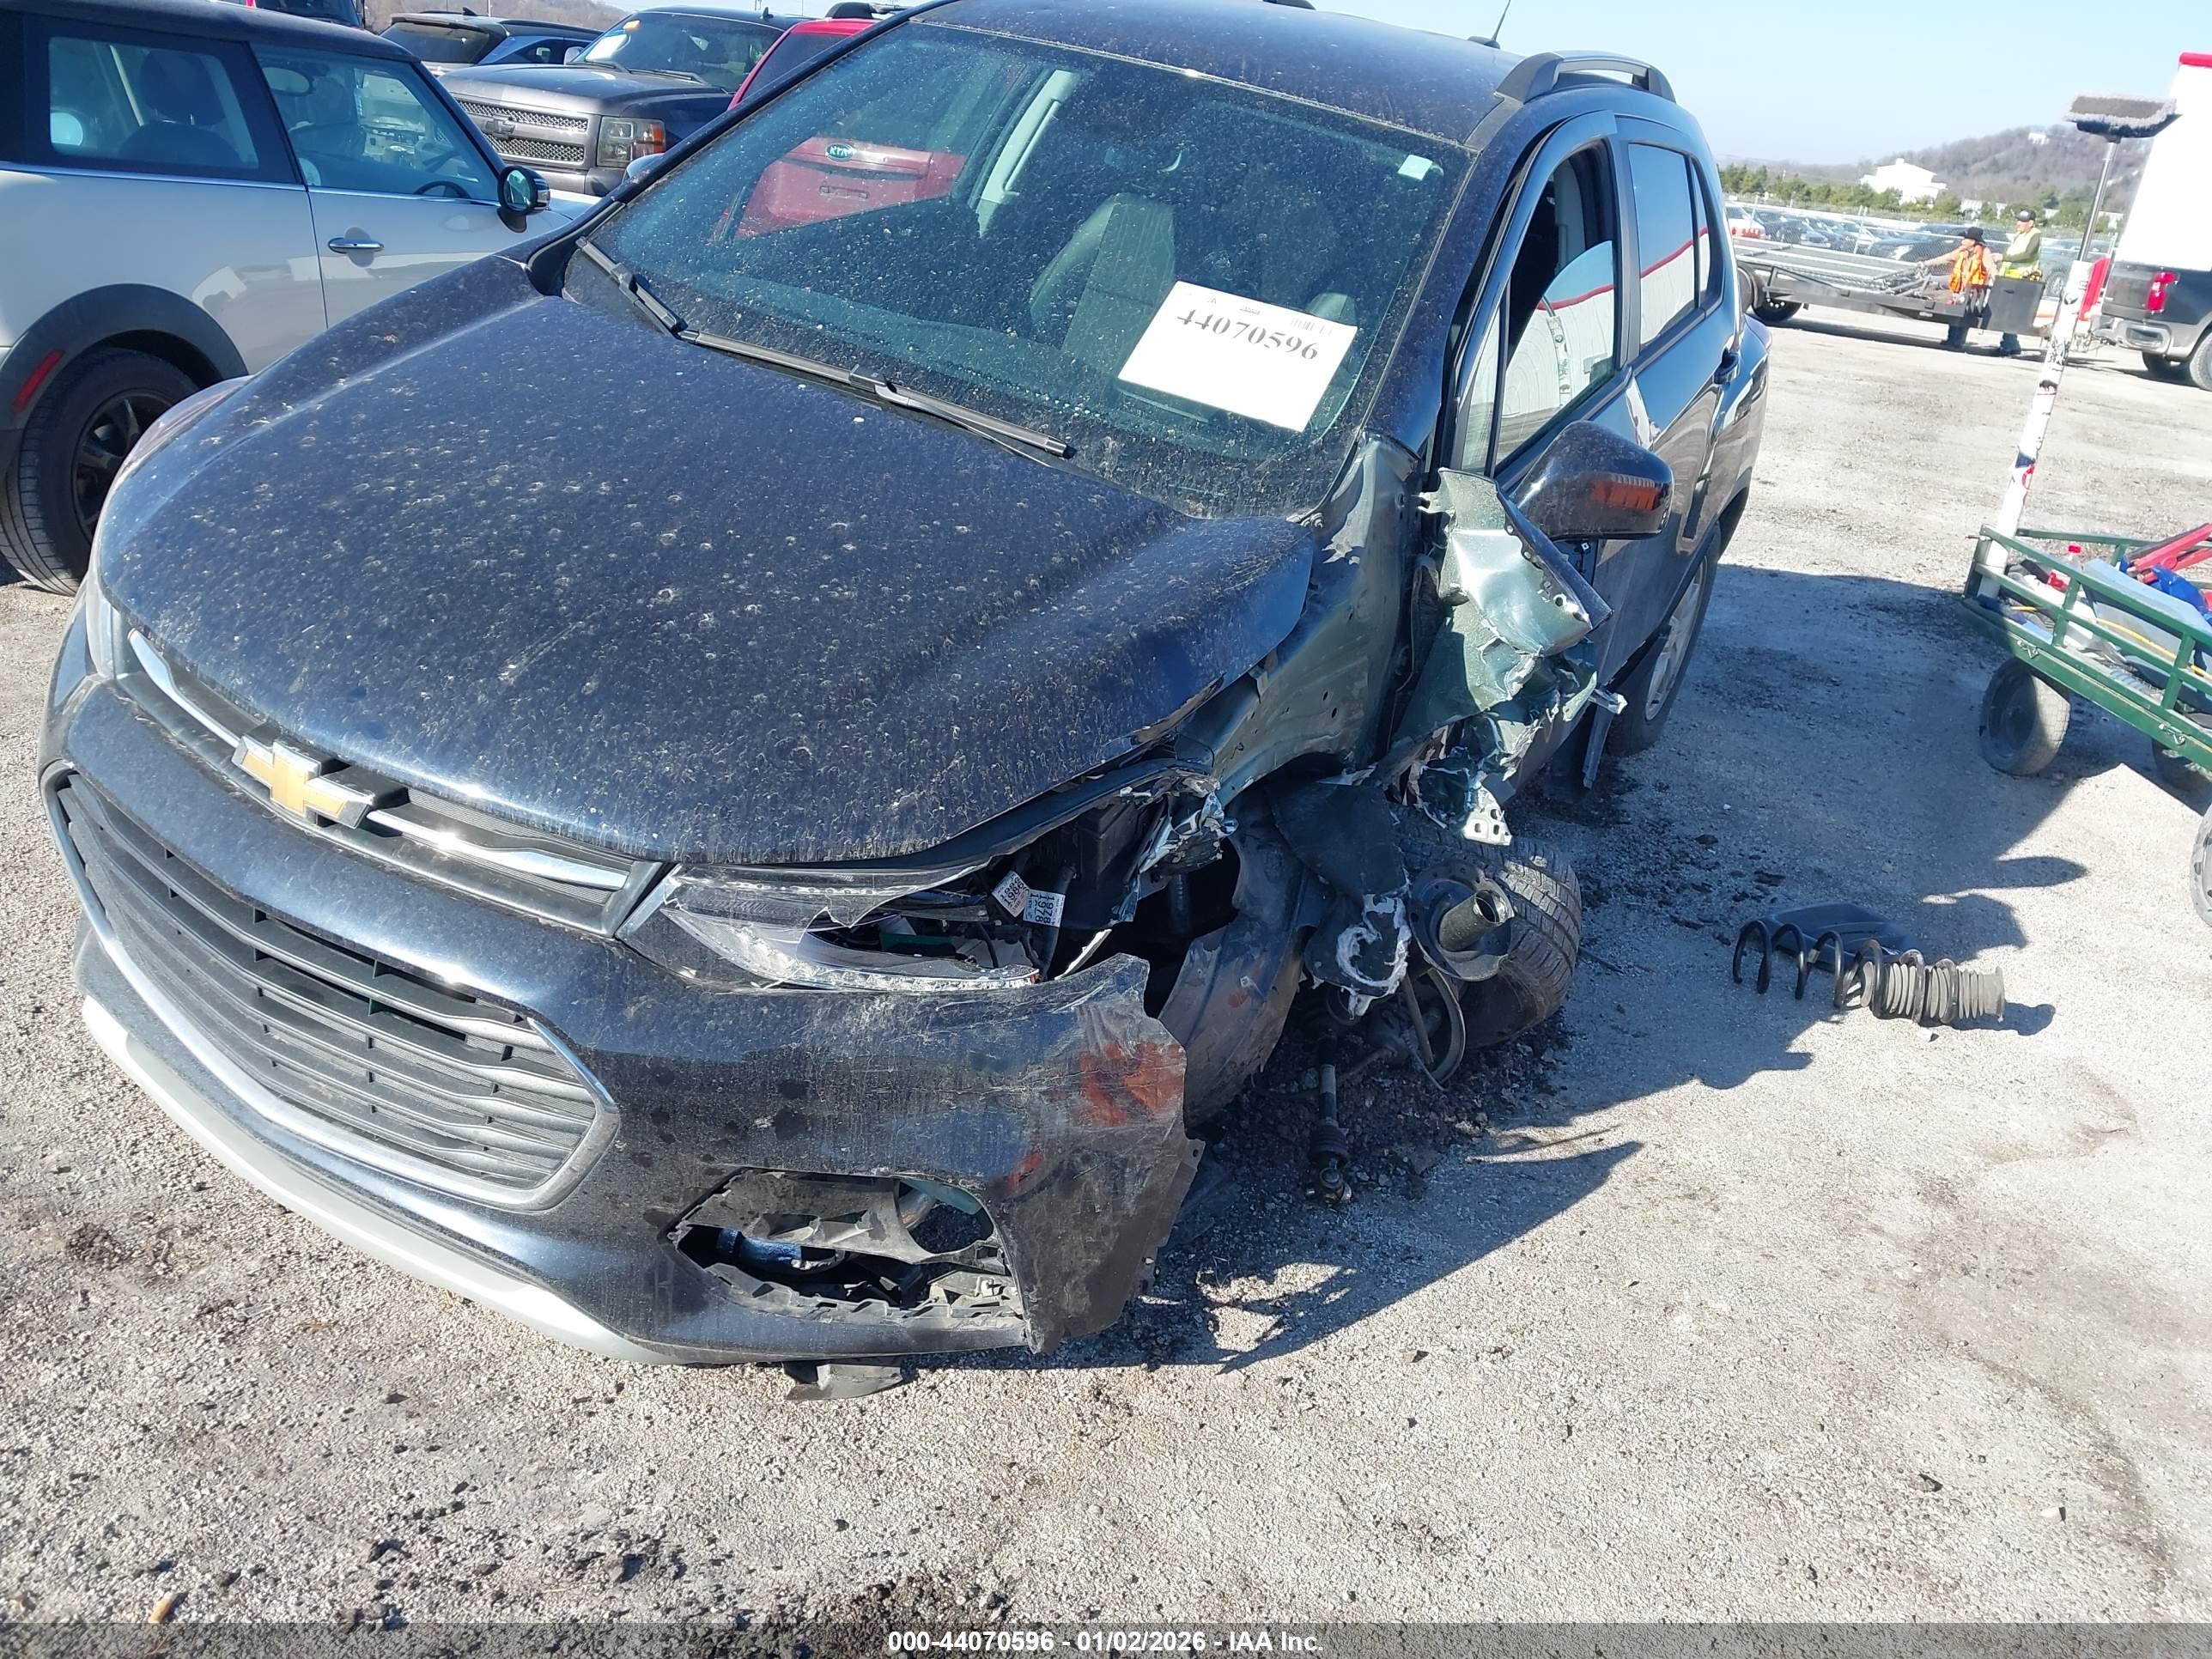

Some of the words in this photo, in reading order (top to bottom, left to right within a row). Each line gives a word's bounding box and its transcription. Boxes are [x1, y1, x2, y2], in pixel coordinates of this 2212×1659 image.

[1177, 309, 1318, 360] 44070596
[1004, 882, 1024, 906] 1986
[1036, 894, 1047, 922] 1978
[1044, 896, 1054, 924] 1978
